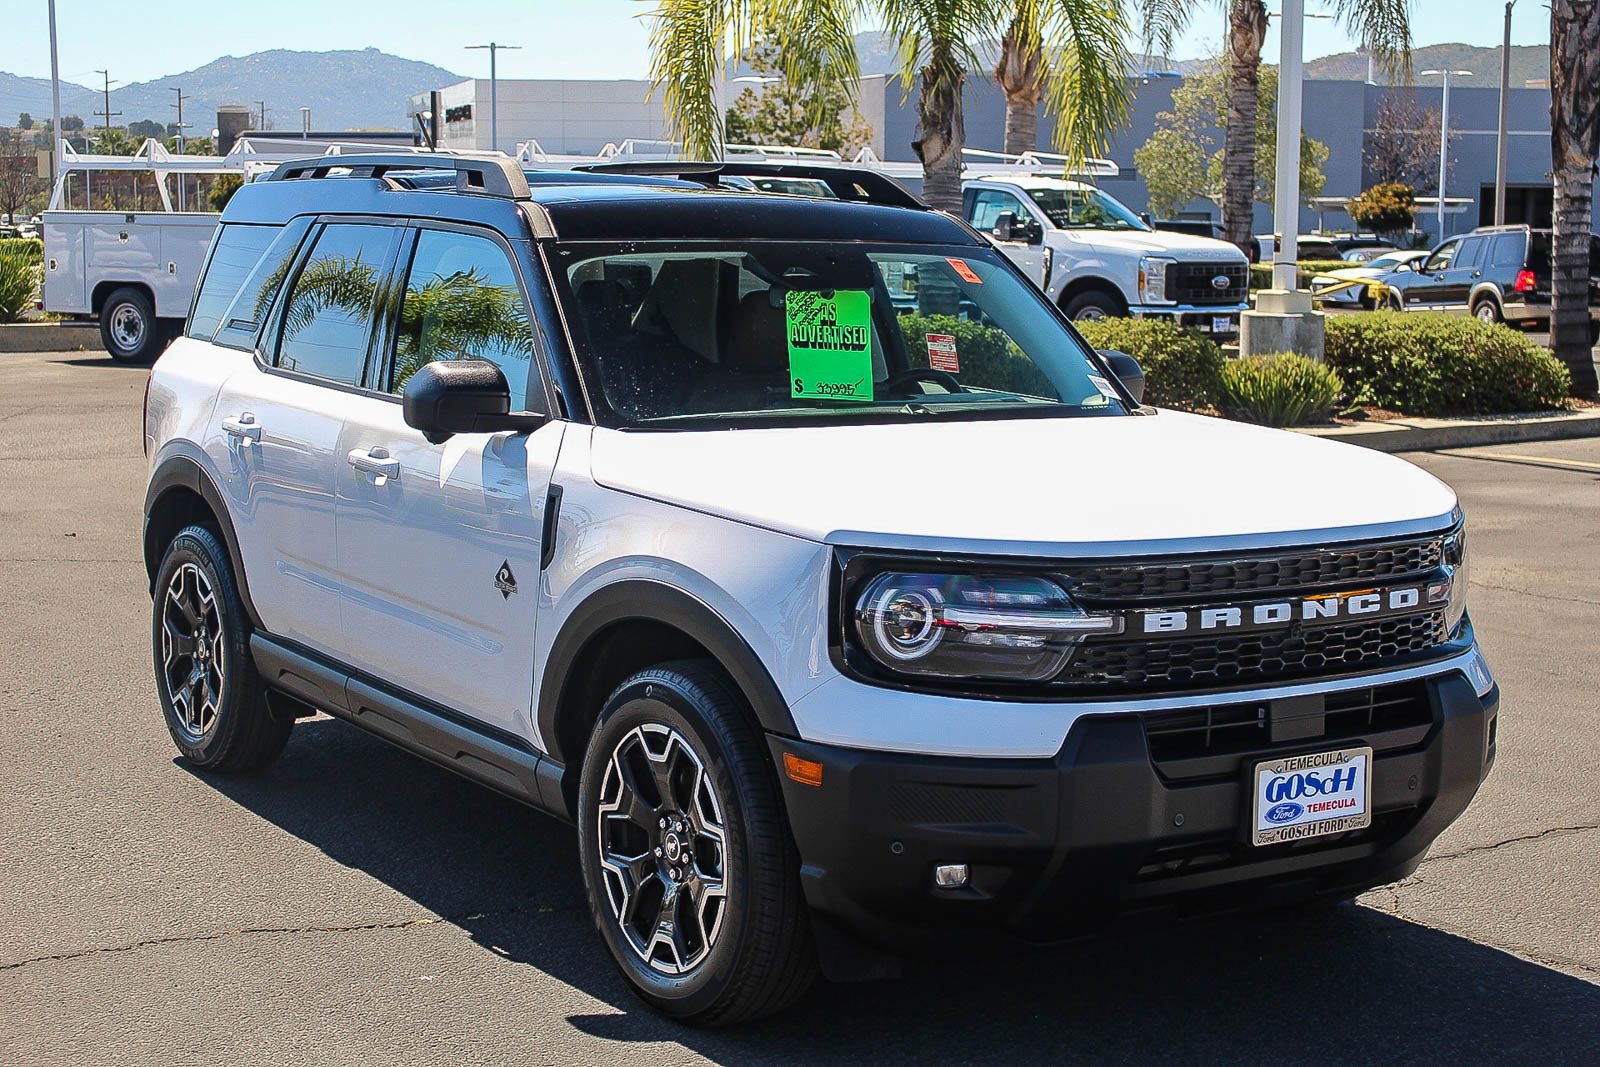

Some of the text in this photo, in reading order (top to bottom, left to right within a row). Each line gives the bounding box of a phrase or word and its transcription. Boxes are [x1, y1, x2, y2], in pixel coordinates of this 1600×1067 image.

[820, 303, 837, 321] AS
[791, 324, 867, 347] ADVERTISED
[794, 378, 804, 393] $
[1143, 588, 1419, 633] BRONCO
[1283, 752, 1343, 771] TEMECULA
[1272, 806, 1296, 820] Ford
[1307, 798, 1356, 813] TEMECULA
[1318, 819, 1344, 834] FORD
